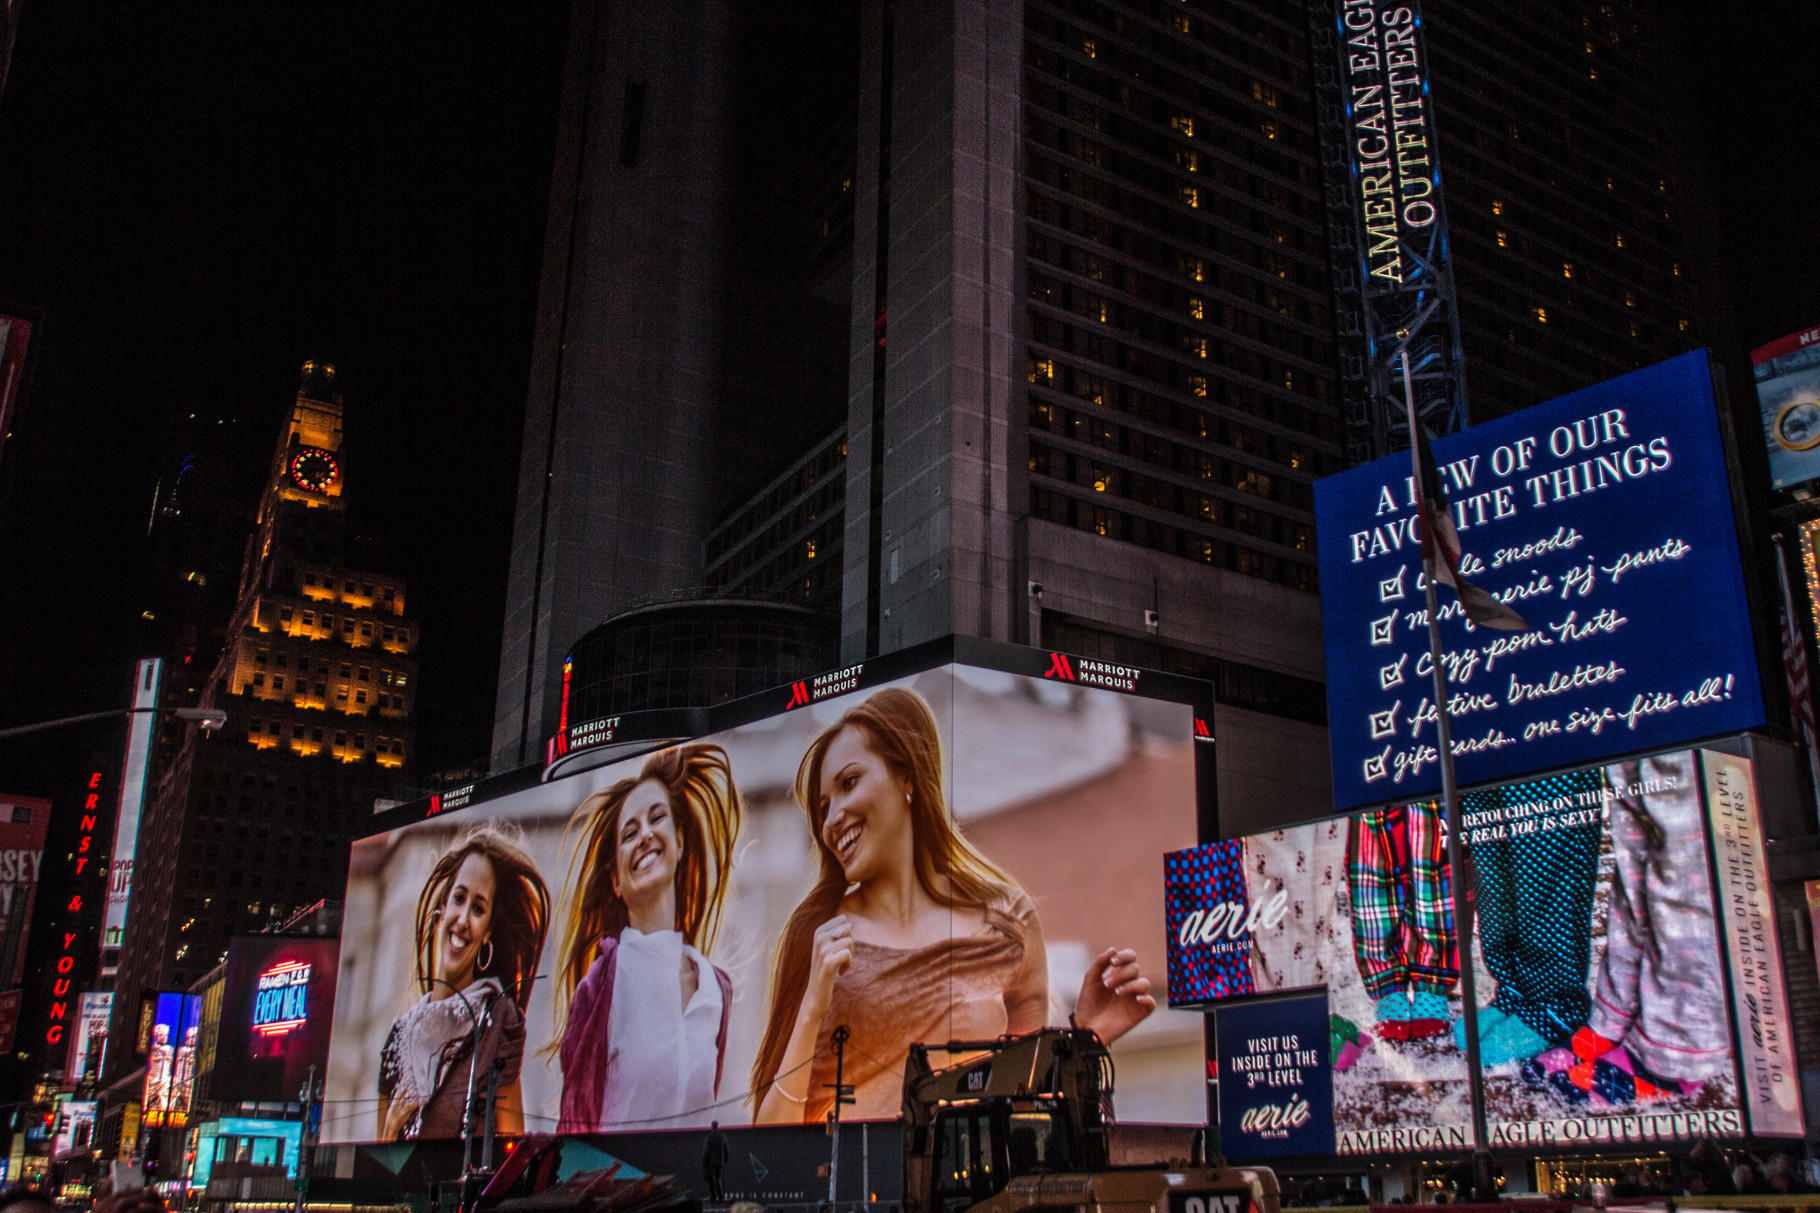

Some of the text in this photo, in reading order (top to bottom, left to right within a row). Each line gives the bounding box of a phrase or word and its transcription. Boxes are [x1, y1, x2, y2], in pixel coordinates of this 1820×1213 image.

[1382, 7, 1436, 228] OUTFITTERS
[1352, 84, 1403, 283] AMERICAN
[1375, 485, 1399, 517] A
[1491, 436, 1537, 477] OF
[1550, 408, 1630, 458] OUR
[1349, 436, 1673, 563] FAVOITE THINGS
[1491, 526, 1583, 571] snoods
[1560, 556, 1597, 598] pj
[1600, 538, 1691, 582] pants
[1482, 630, 1553, 673] pom
[1549, 607, 1628, 636] hats
[812, 677, 858, 699] MARQUIS
[813, 664, 864, 687] MARRIOTT
[1079, 659, 1141, 680] MARRIOTT
[1080, 671, 1134, 690] MARQUIS
[1407, 660, 1626, 739] fetive bralettes
[570, 730, 613, 750] MARQUIS
[571, 716, 621, 738] MARRIOTT
[1393, 744, 1439, 784] gift
[1523, 716, 1562, 742] one
[1565, 704, 1615, 736] size
[1616, 691, 1680, 731] fits
[1681, 673, 1736, 708] all!
[442, 795, 471, 810] MARQUIS
[443, 784, 475, 801] MARRIOTT
[1461, 800, 1549, 829] RETOUCHING
[1553, 794, 1575, 812] ON
[1627, 776, 1678, 797] GIRLS!
[1716, 770, 1733, 816] LEVEL
[1471, 825, 1509, 843] REAL
[1511, 819, 1540, 837] YOU
[1542, 816, 1557, 831] IS
[1728, 856, 1742, 886] THE
[46, 772, 102, 1045] ERNST & YOUNG
[1180, 879, 1289, 947] aerie
[1734, 894, 1746, 917] ON
[1211, 940, 1254, 954] AERIE.COM
[1733, 792, 1782, 1083] OF AMERICAN EAGLE OUTFITTERS
[1737, 926, 1755, 985] INSIDE
[259, 968, 310, 990] RAMEN FOR
[254, 985, 307, 1024] EVERY MEAL
[1744, 992, 1764, 1048] aerie
[1231, 1049, 1318, 1073] INSIDE ON THE
[1247, 1034, 1300, 1055] VISIT US
[968, 1071, 984, 1091] CAT
[1247, 1068, 1304, 1089] 3RD LEVEL
[1755, 1056, 1772, 1104] VISIT
[1241, 1092, 1311, 1133] aerie
[1339, 1110, 1741, 1152] AMERICAN AGLE OUTFITTERS
